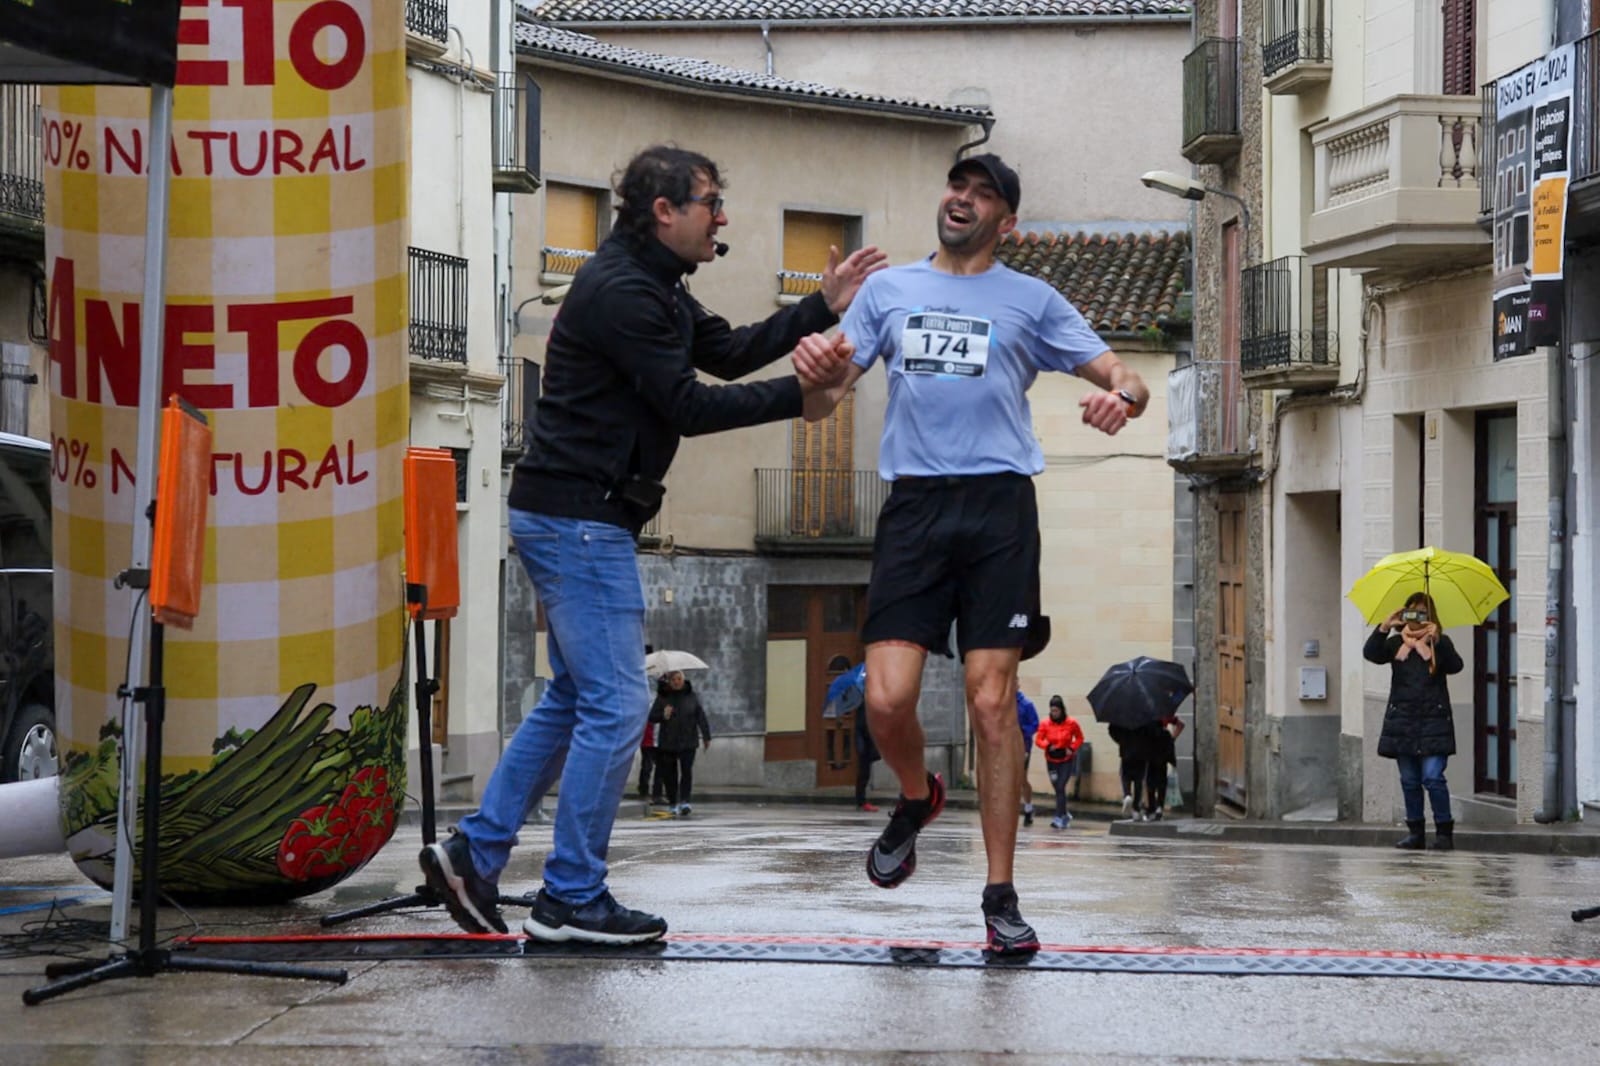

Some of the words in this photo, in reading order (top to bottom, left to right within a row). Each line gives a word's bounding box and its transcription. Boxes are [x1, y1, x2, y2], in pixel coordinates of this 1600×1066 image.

[48, 256, 369, 409] ANETO
[921, 333, 970, 358] 174
[111, 439, 369, 497] NTURAL
